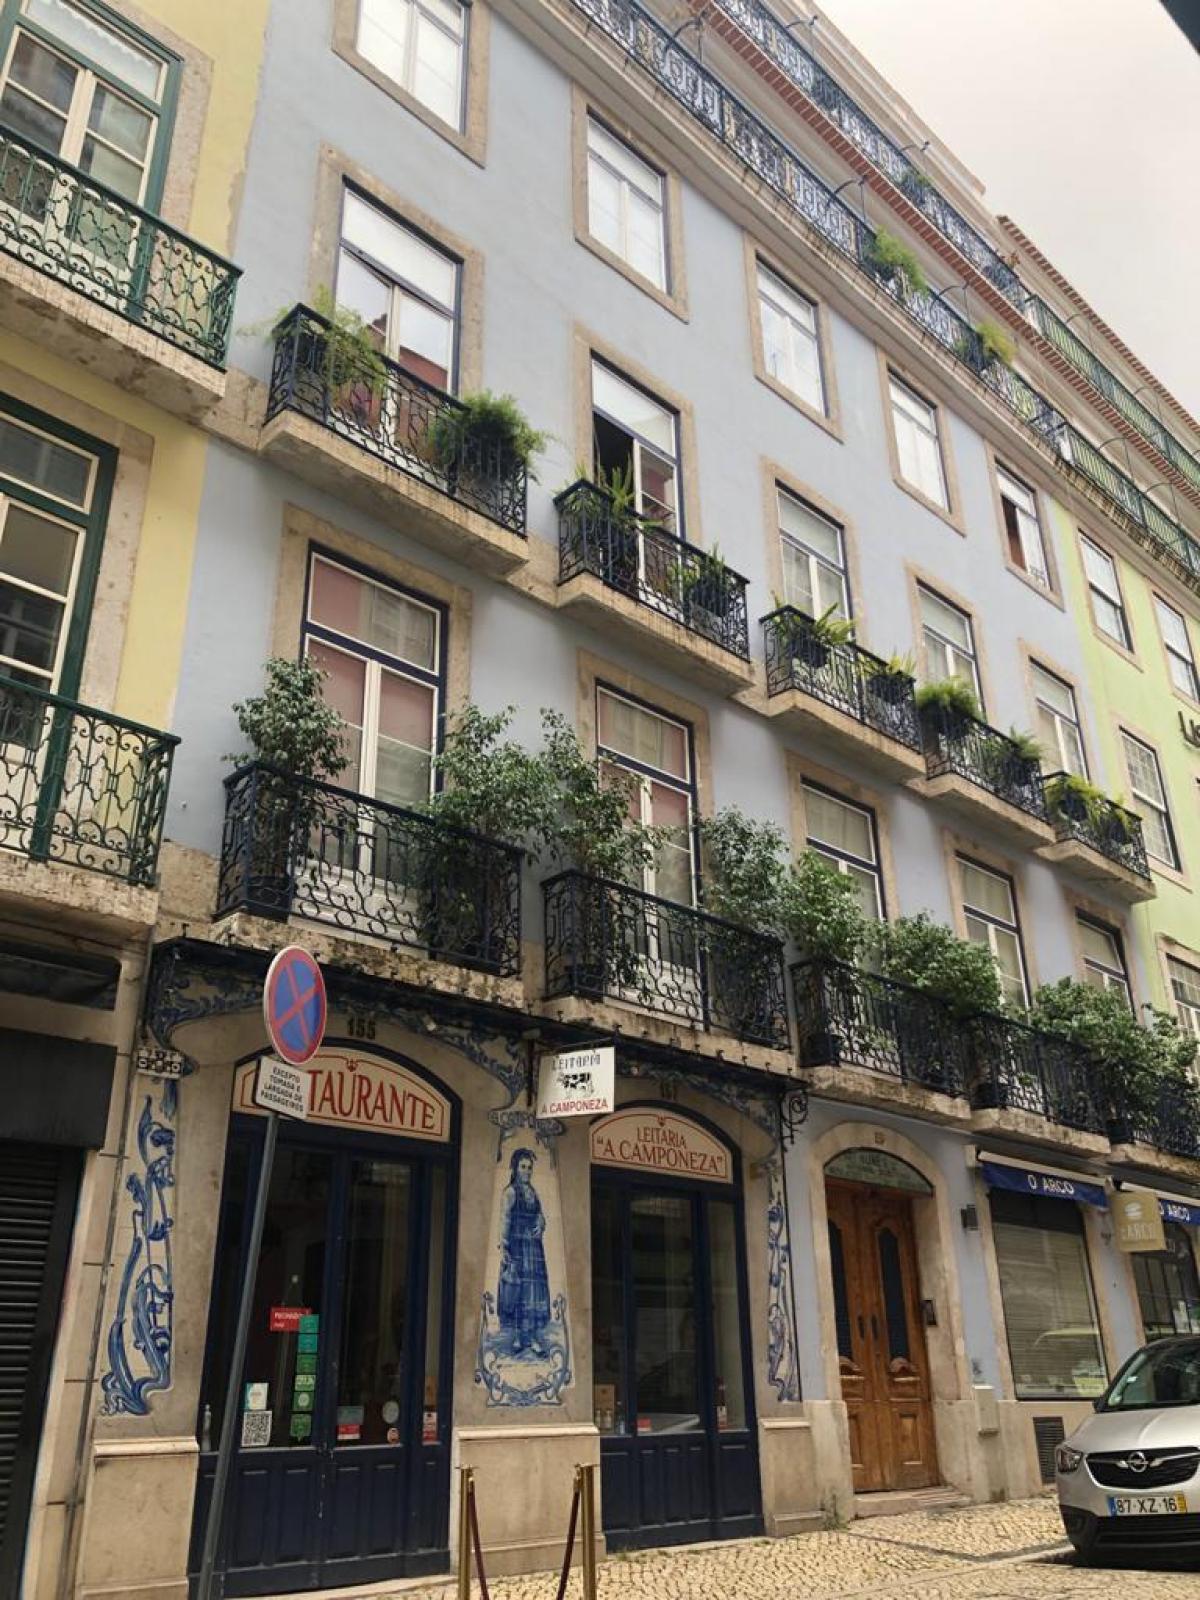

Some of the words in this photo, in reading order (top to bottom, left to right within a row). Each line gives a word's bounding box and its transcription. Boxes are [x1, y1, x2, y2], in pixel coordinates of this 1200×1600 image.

[347, 1016, 376, 1040] 155
[307, 1070, 436, 1130] TAURANTE
[541, 1105, 548, 1114] A
[549, 1098, 609, 1114] CAMPONEZA
[636, 1126, 688, 1149] LEITARIA
[1027, 1174, 1037, 1190] O
[1043, 1177, 1075, 1195] ARCO
